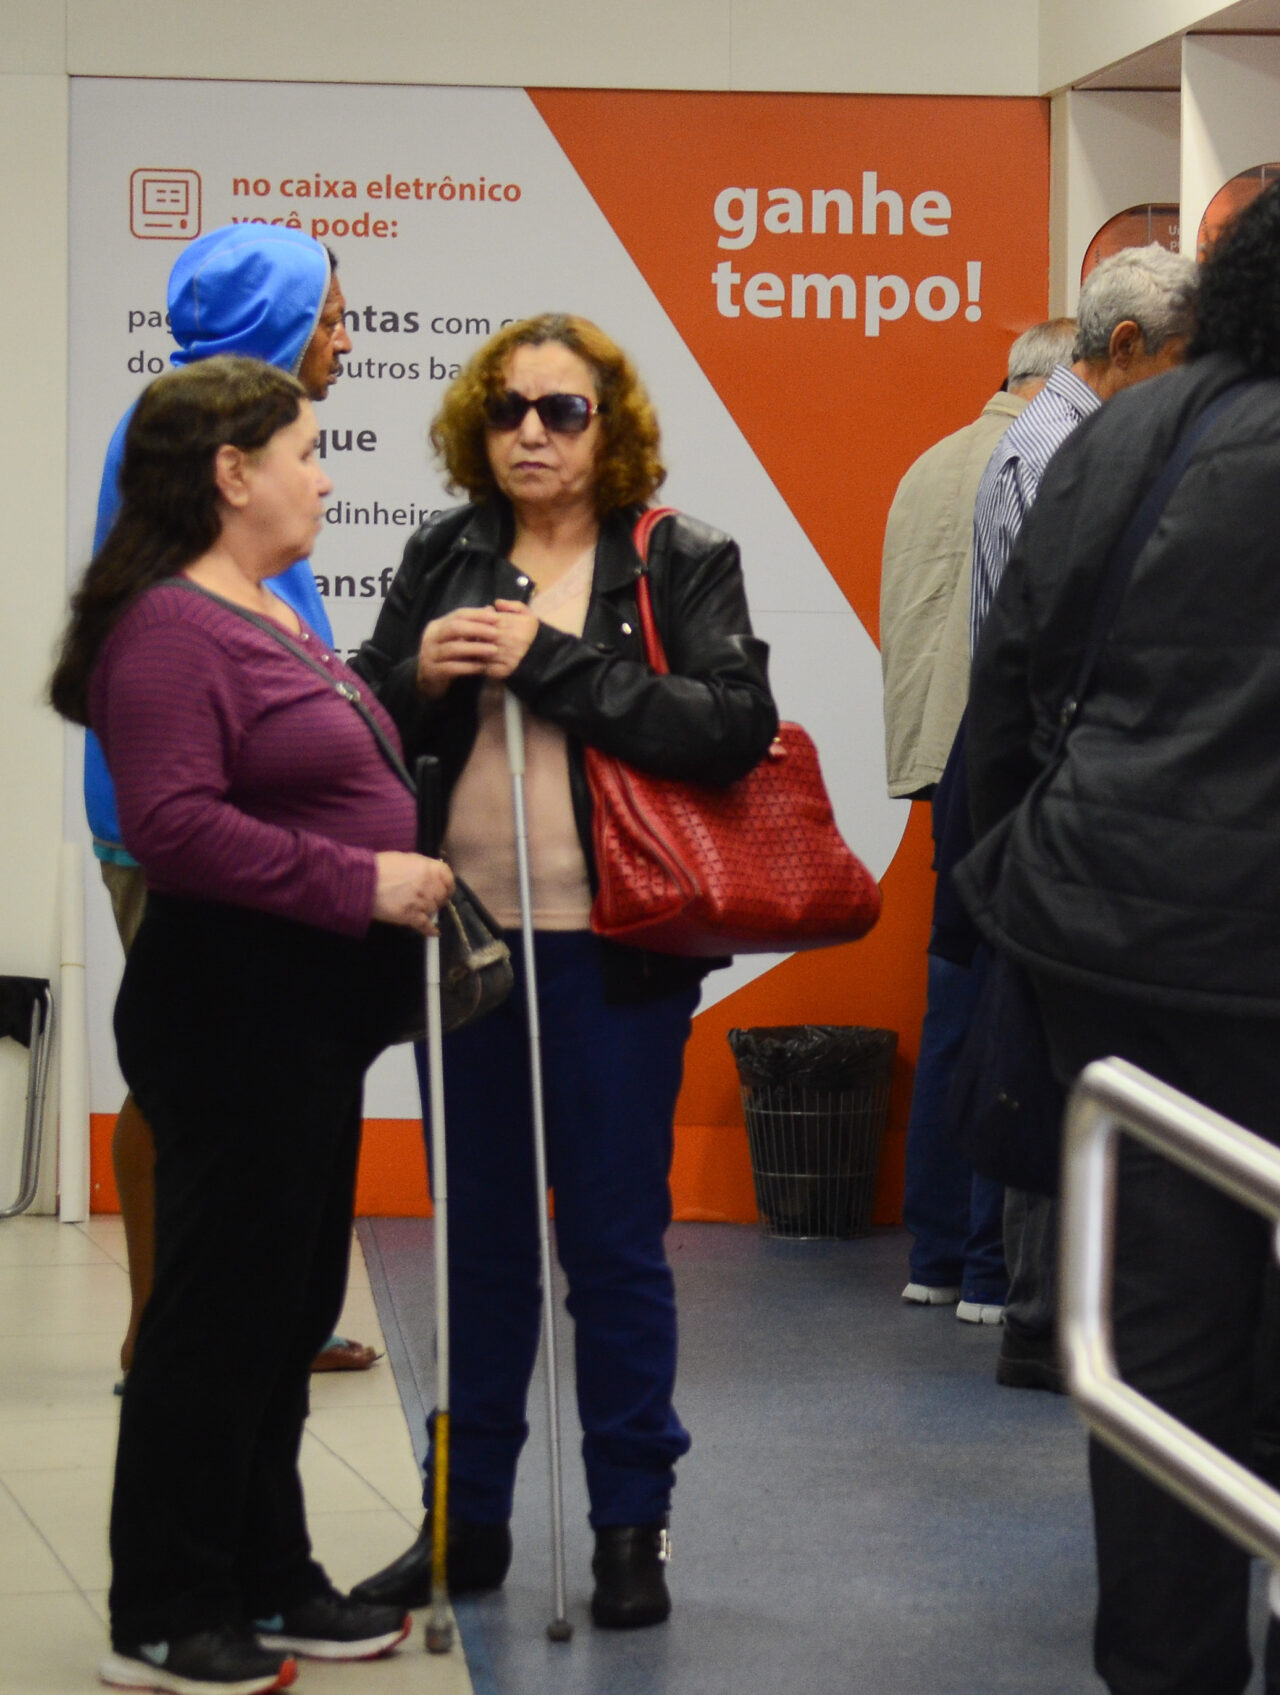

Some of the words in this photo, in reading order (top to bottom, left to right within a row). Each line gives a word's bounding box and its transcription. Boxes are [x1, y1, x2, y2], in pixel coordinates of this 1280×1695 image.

[232, 177, 271, 197] no
[279, 172, 358, 199] caixa
[366, 173, 522, 203] eletrônico
[311, 211, 399, 239] pode:
[713, 170, 953, 251] ganhe
[710, 259, 983, 338] tempo!
[430, 316, 491, 336] com
[127, 350, 165, 375] do
